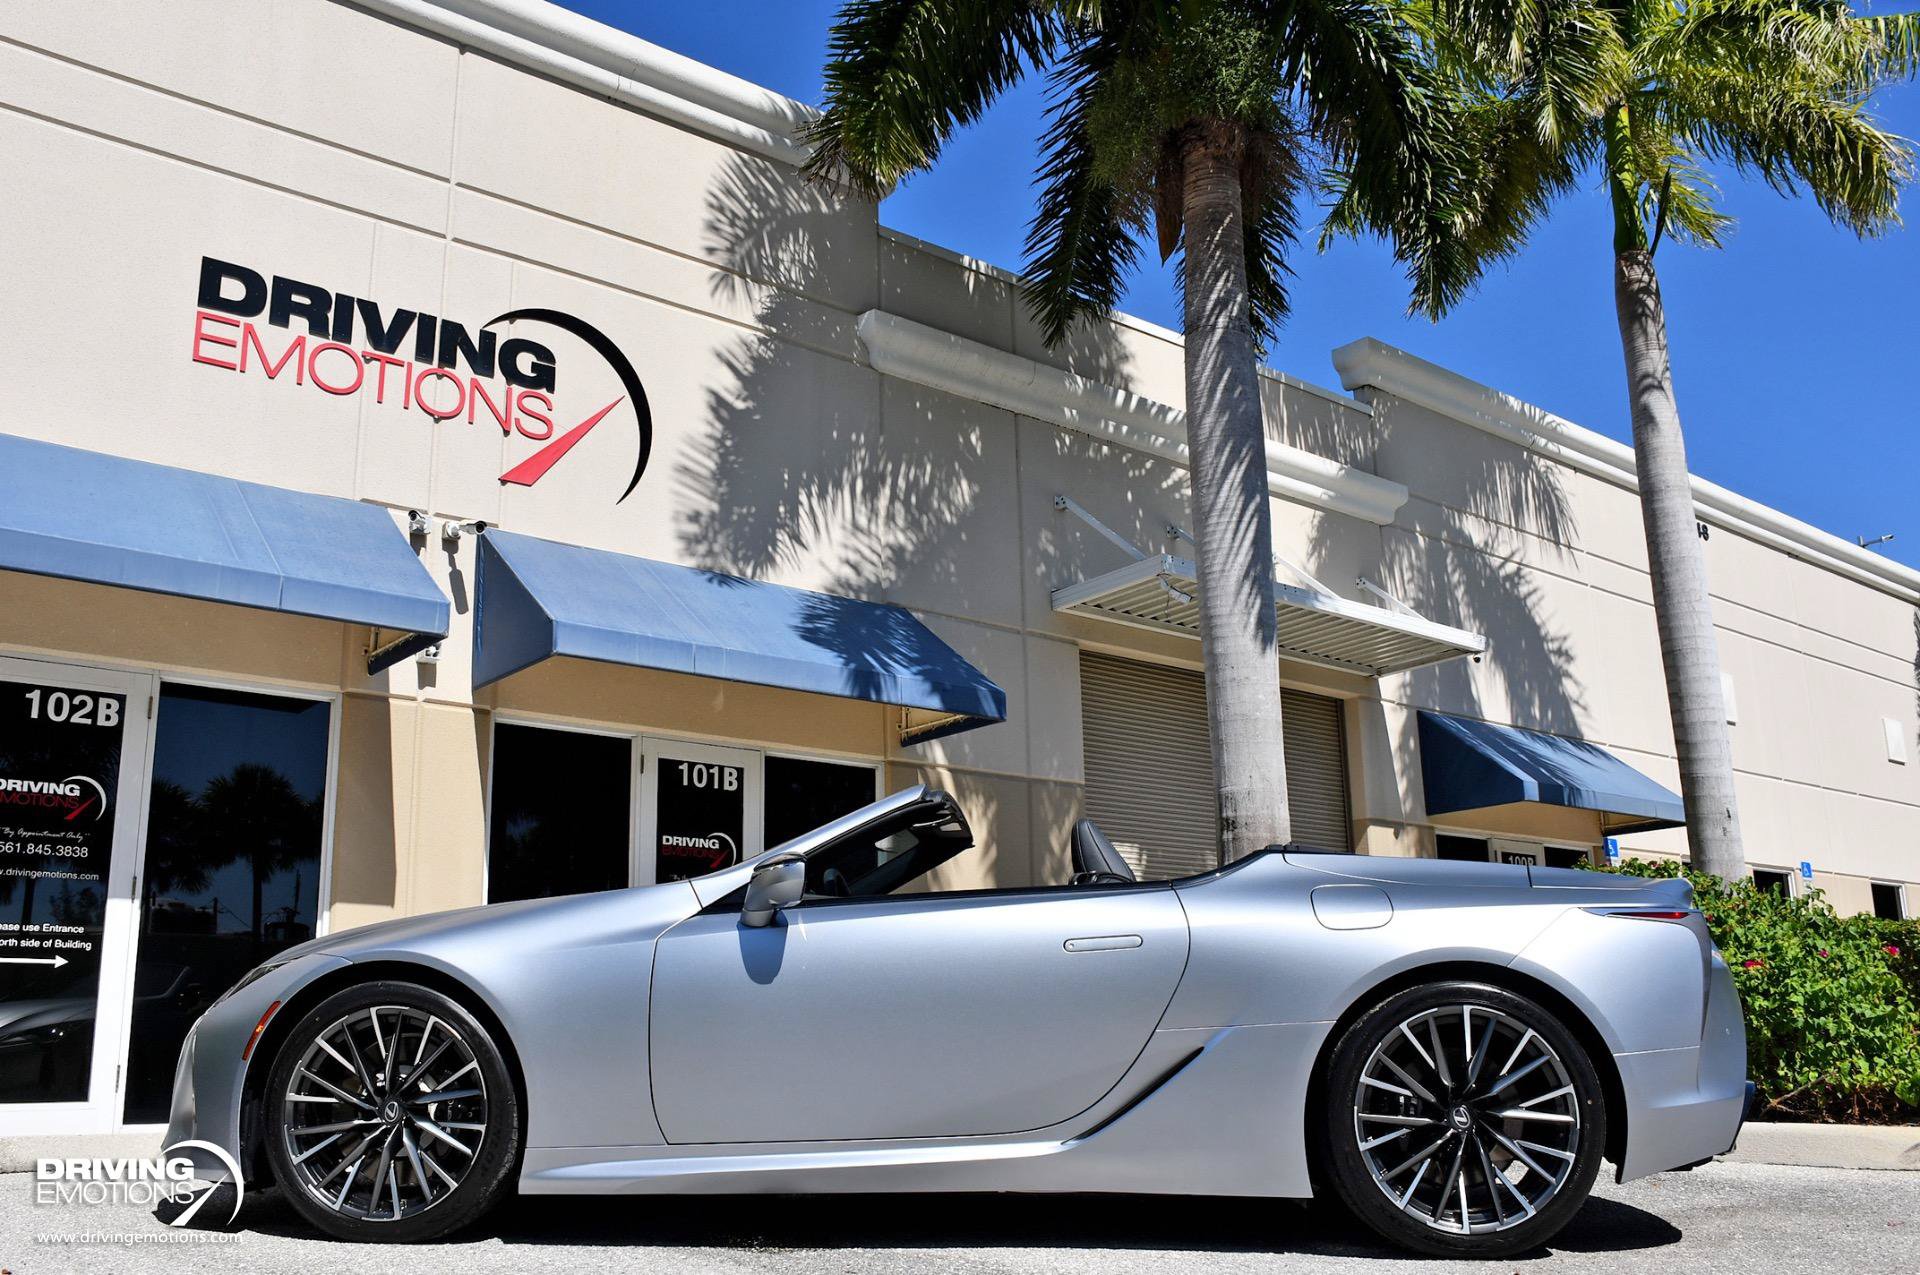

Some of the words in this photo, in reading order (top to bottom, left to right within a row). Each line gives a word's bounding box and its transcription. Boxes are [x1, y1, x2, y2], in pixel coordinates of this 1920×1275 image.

[197, 256, 557, 393] DRIVING
[192, 311, 555, 440] EMOTIONS
[25, 689, 120, 727] 102B
[678, 763, 739, 791] 101B
[0, 790, 80, 809] MOTIONS
[17, 828, 65, 838] Appointment
[662, 835, 720, 849] DRIVING
[22, 924, 41, 932] use
[42, 923, 85, 934] Entrance
[0, 938, 18, 947] orth
[20, 938, 41, 948] side
[42, 939, 53, 948] of
[54, 939, 92, 951] Building
